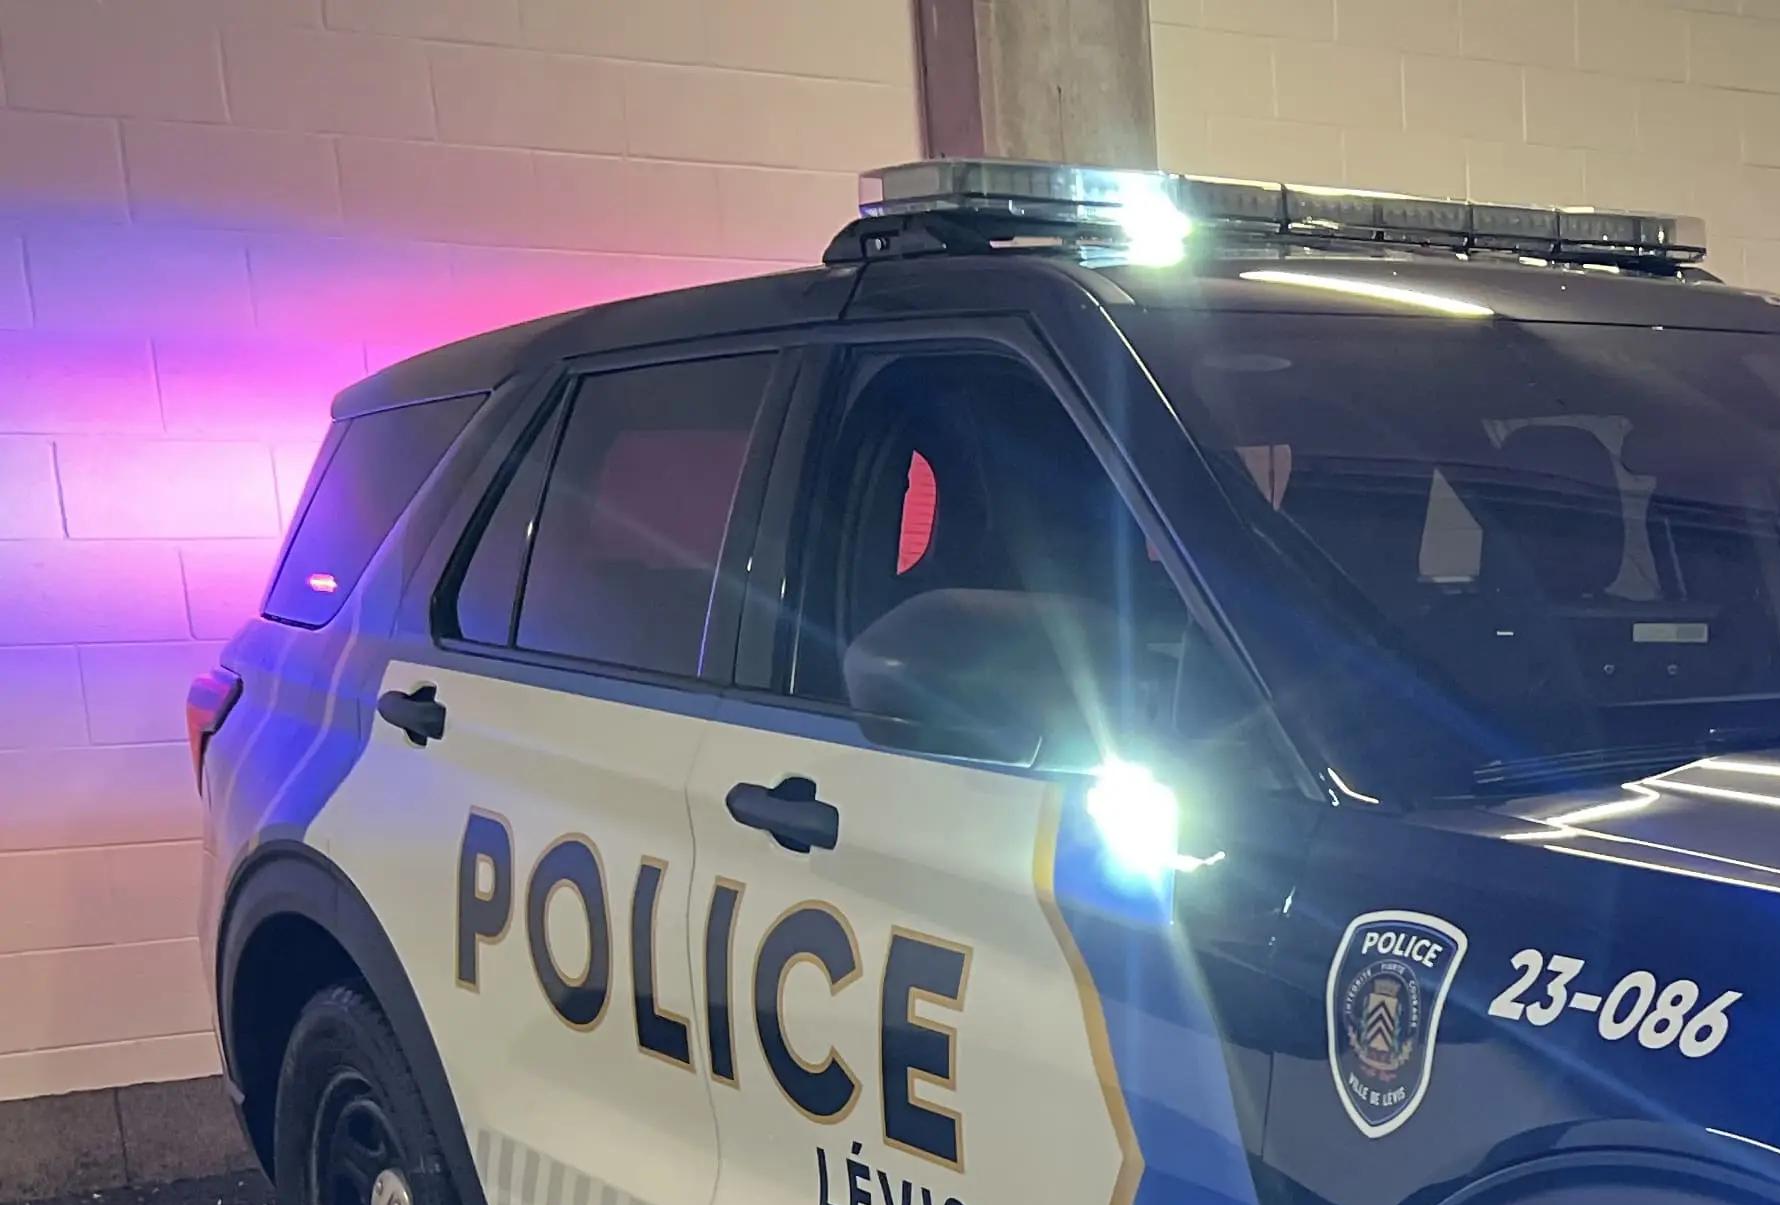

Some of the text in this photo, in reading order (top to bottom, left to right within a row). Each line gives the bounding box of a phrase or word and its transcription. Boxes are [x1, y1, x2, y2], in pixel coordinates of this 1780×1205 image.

[1361, 931, 1443, 968] POLICE
[455, 805, 974, 1174] POLICE
[1487, 948, 1744, 1059] 23-086
[1370, 1091, 1381, 1106] DE
